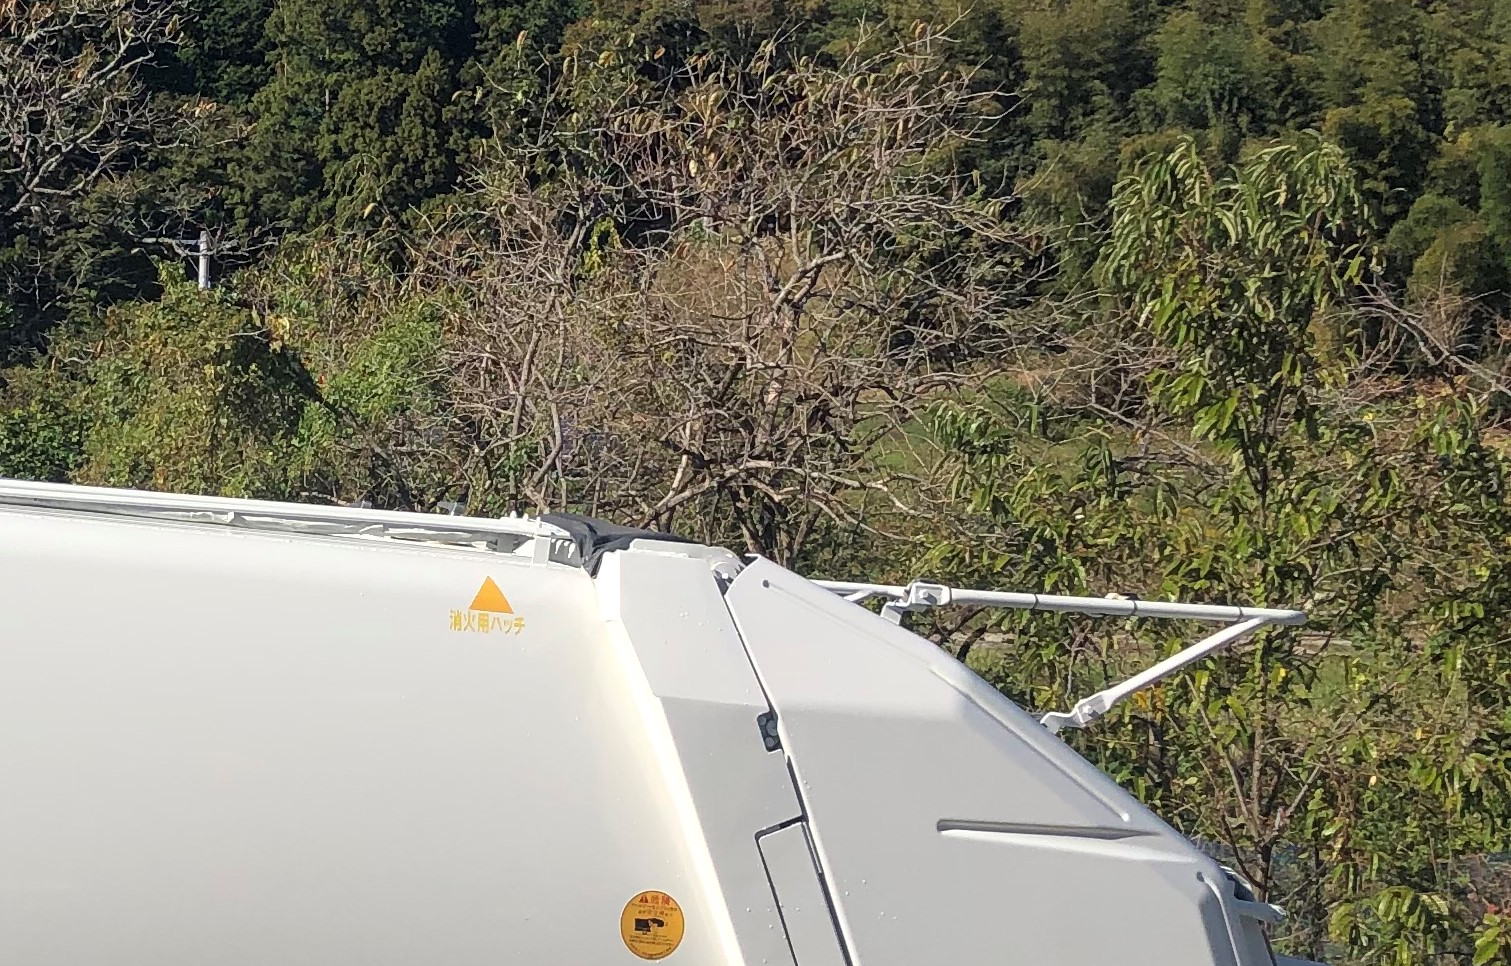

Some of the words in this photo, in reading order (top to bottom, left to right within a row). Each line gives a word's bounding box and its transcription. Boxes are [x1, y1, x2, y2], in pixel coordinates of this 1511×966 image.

[449, 610, 525, 635] 消火用ハッチ
